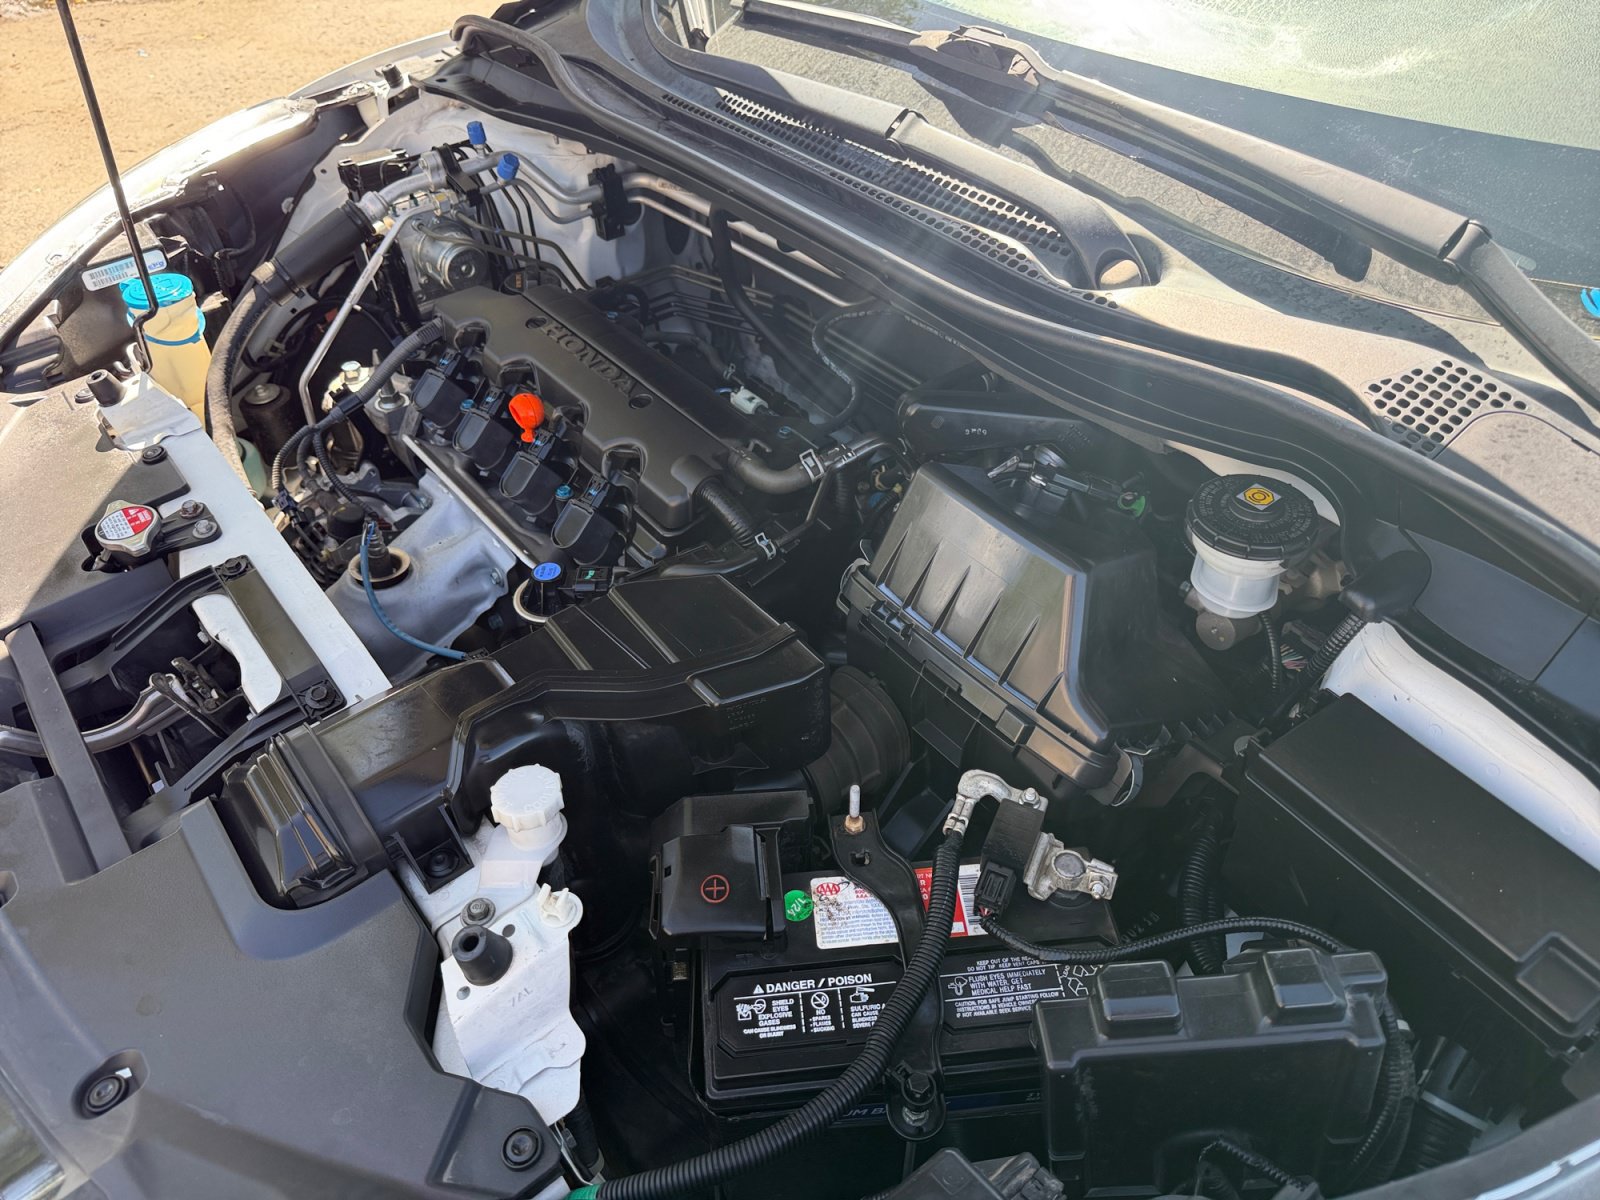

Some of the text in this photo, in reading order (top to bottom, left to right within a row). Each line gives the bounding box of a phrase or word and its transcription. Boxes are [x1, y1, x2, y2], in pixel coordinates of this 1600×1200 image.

[543, 325, 638, 398] HONDA
[968, 969, 1046, 983] FLUSH EYES IMMEDIATELY
[766, 979, 815, 993] DANGER
[828, 973, 873, 987] POISON
[970, 981, 986, 989] WITH
[1010, 977, 1023, 985] GET
[971, 983, 1032, 997] MEDICAL HELP FAST
[771, 998, 794, 1006] SHIELD
[1015, 993, 1039, 1001] STARTING
[850, 1003, 880, 1012] SULFURIC
[956, 1004, 990, 1013] INSTRUCTIONS
[997, 1001, 1017, 1009] VEHICLE
[758, 1011, 793, 1020] EXPLOSIVE
[973, 1009, 998, 1017] AVAILABLE
[852, 1021, 871, 1029] SEVERE
